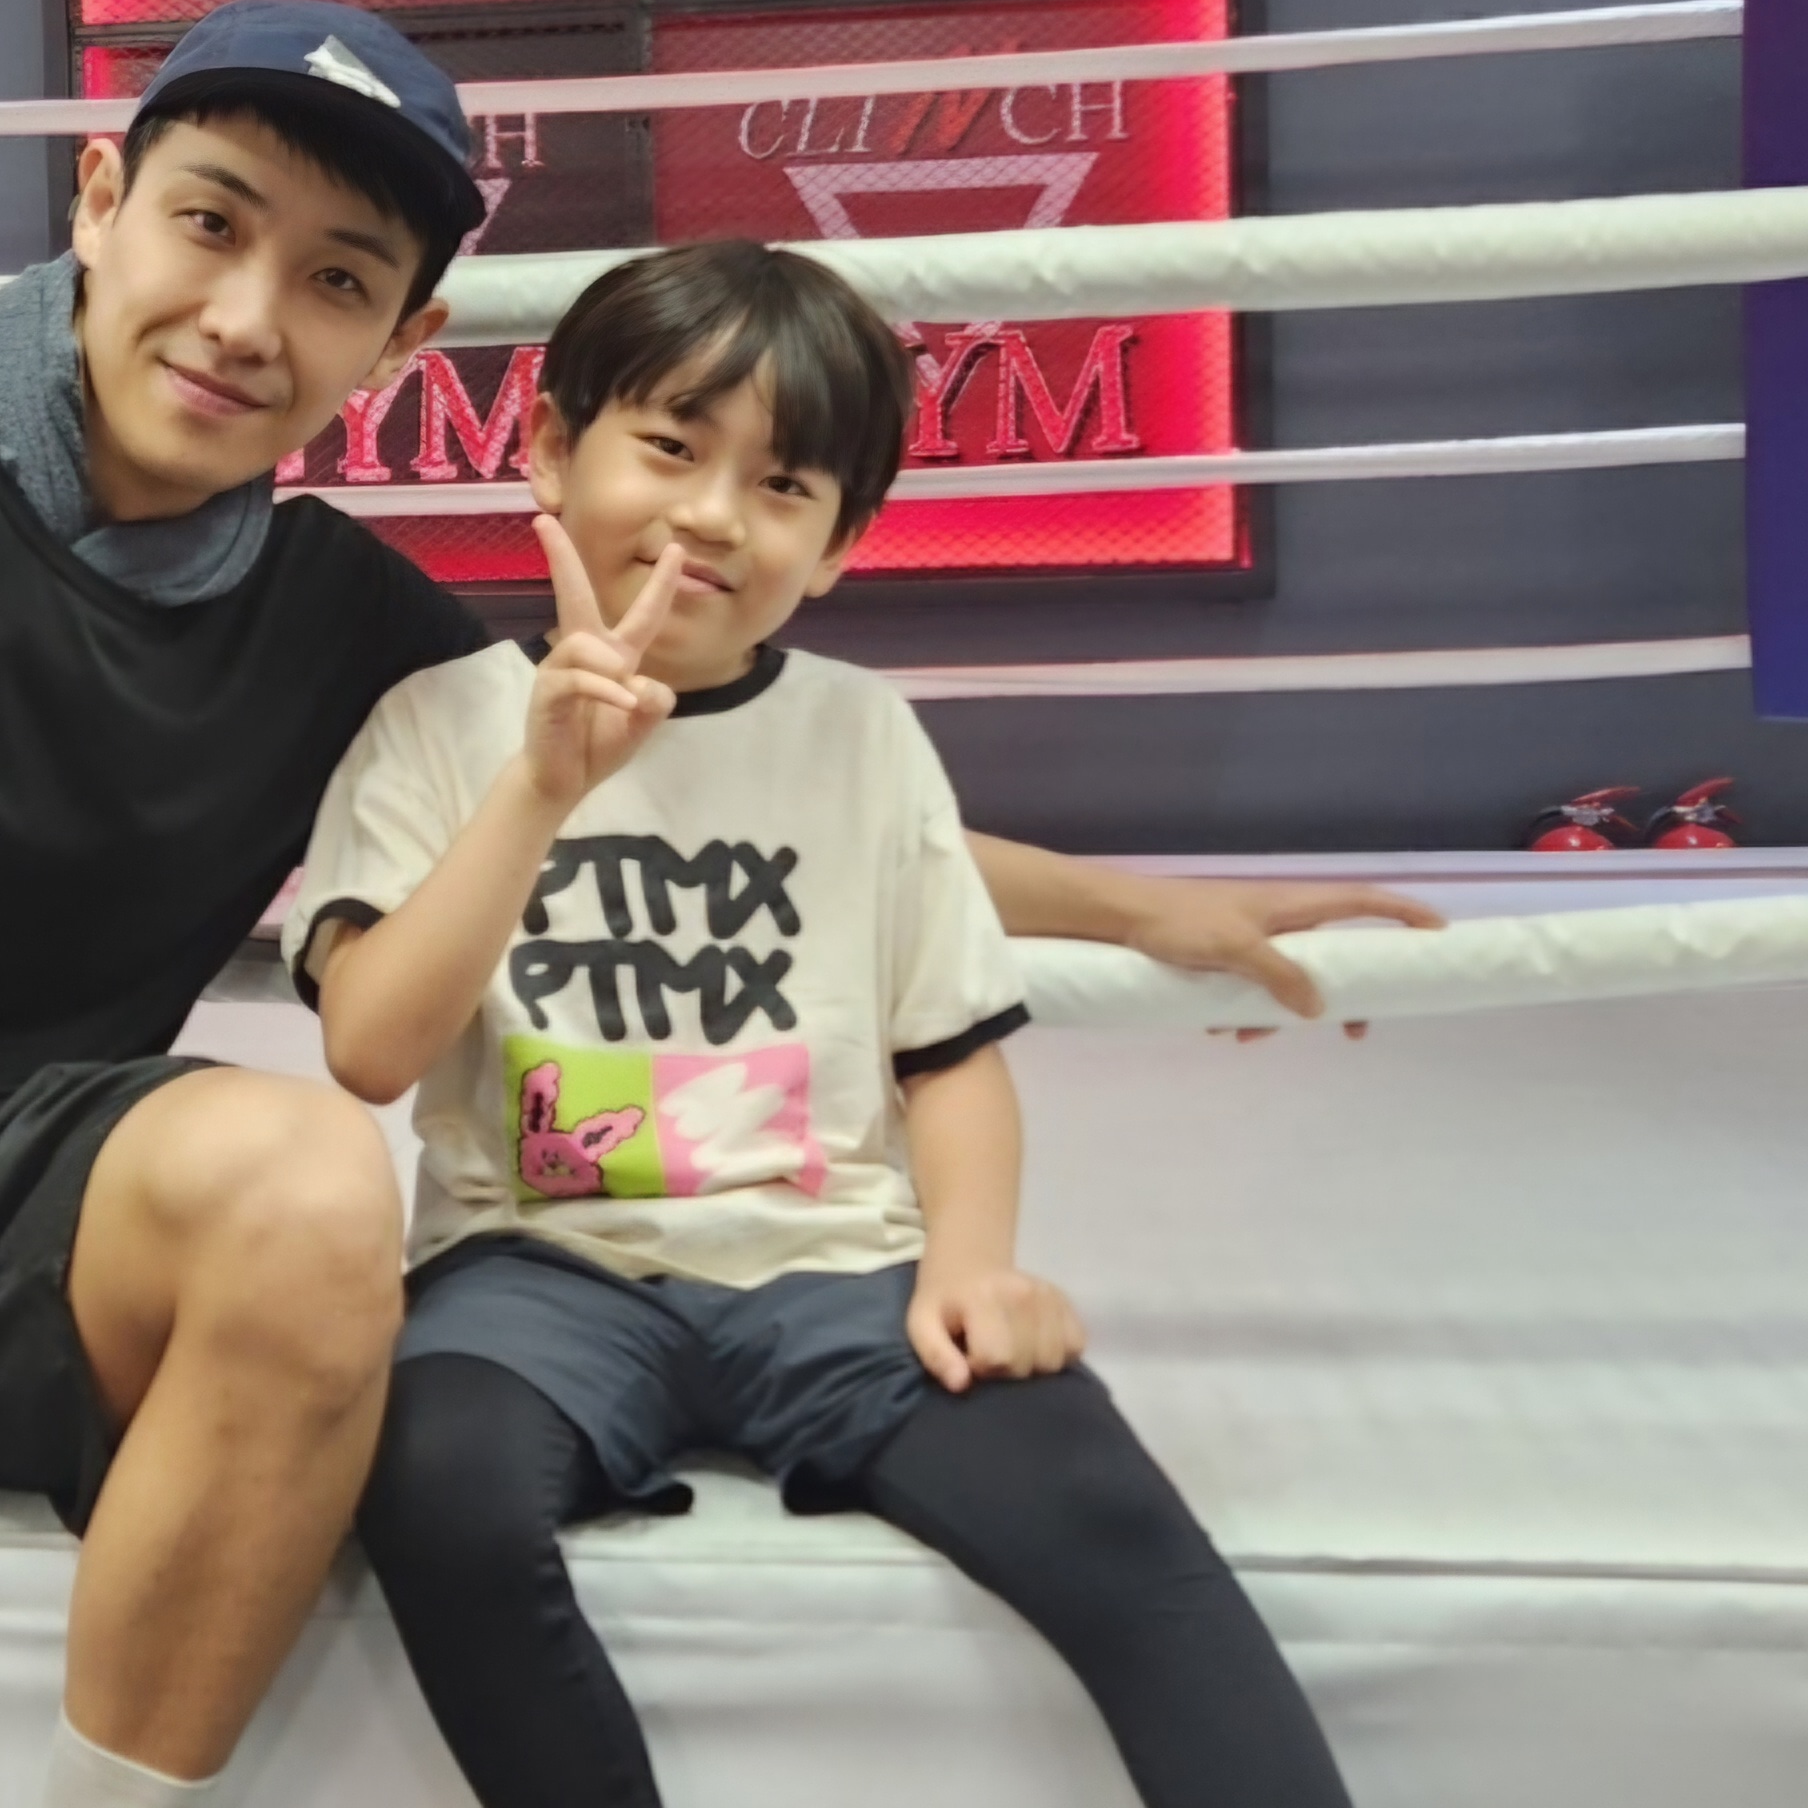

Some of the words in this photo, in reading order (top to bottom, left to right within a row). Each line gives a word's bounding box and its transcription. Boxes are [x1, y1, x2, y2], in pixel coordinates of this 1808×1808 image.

[275, 346, 546, 484] YM
[907, 322, 1140, 458] YM
[510, 940, 797, 1045] PTMX
